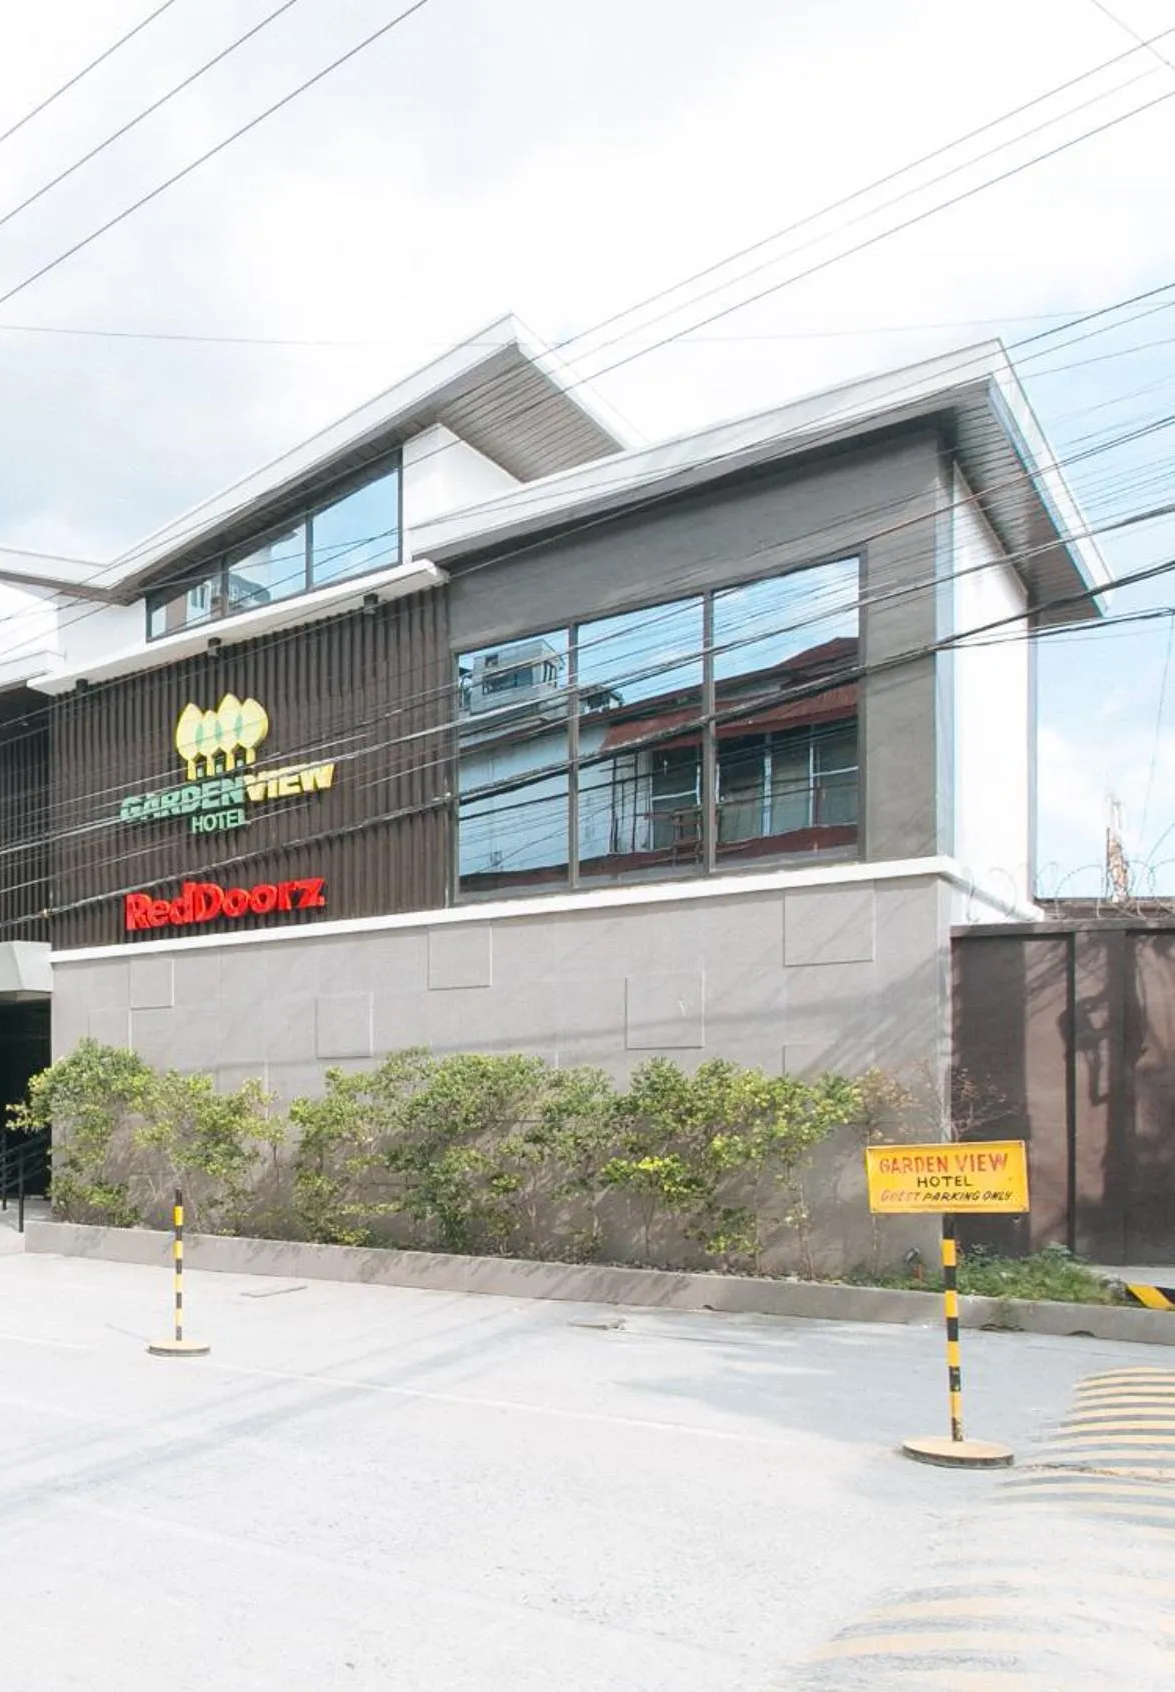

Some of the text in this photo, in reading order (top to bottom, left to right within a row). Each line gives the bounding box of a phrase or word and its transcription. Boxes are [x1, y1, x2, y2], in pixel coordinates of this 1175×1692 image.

[191, 808, 245, 834] HOTEL
[126, 877, 326, 930] RedDoorz
[879, 1153, 1008, 1174] GARDEN VIEW
[917, 1175, 973, 1188] HOTEL
[922, 1190, 980, 1202] PARKING
[982, 1190, 1013, 1201] ONLY
